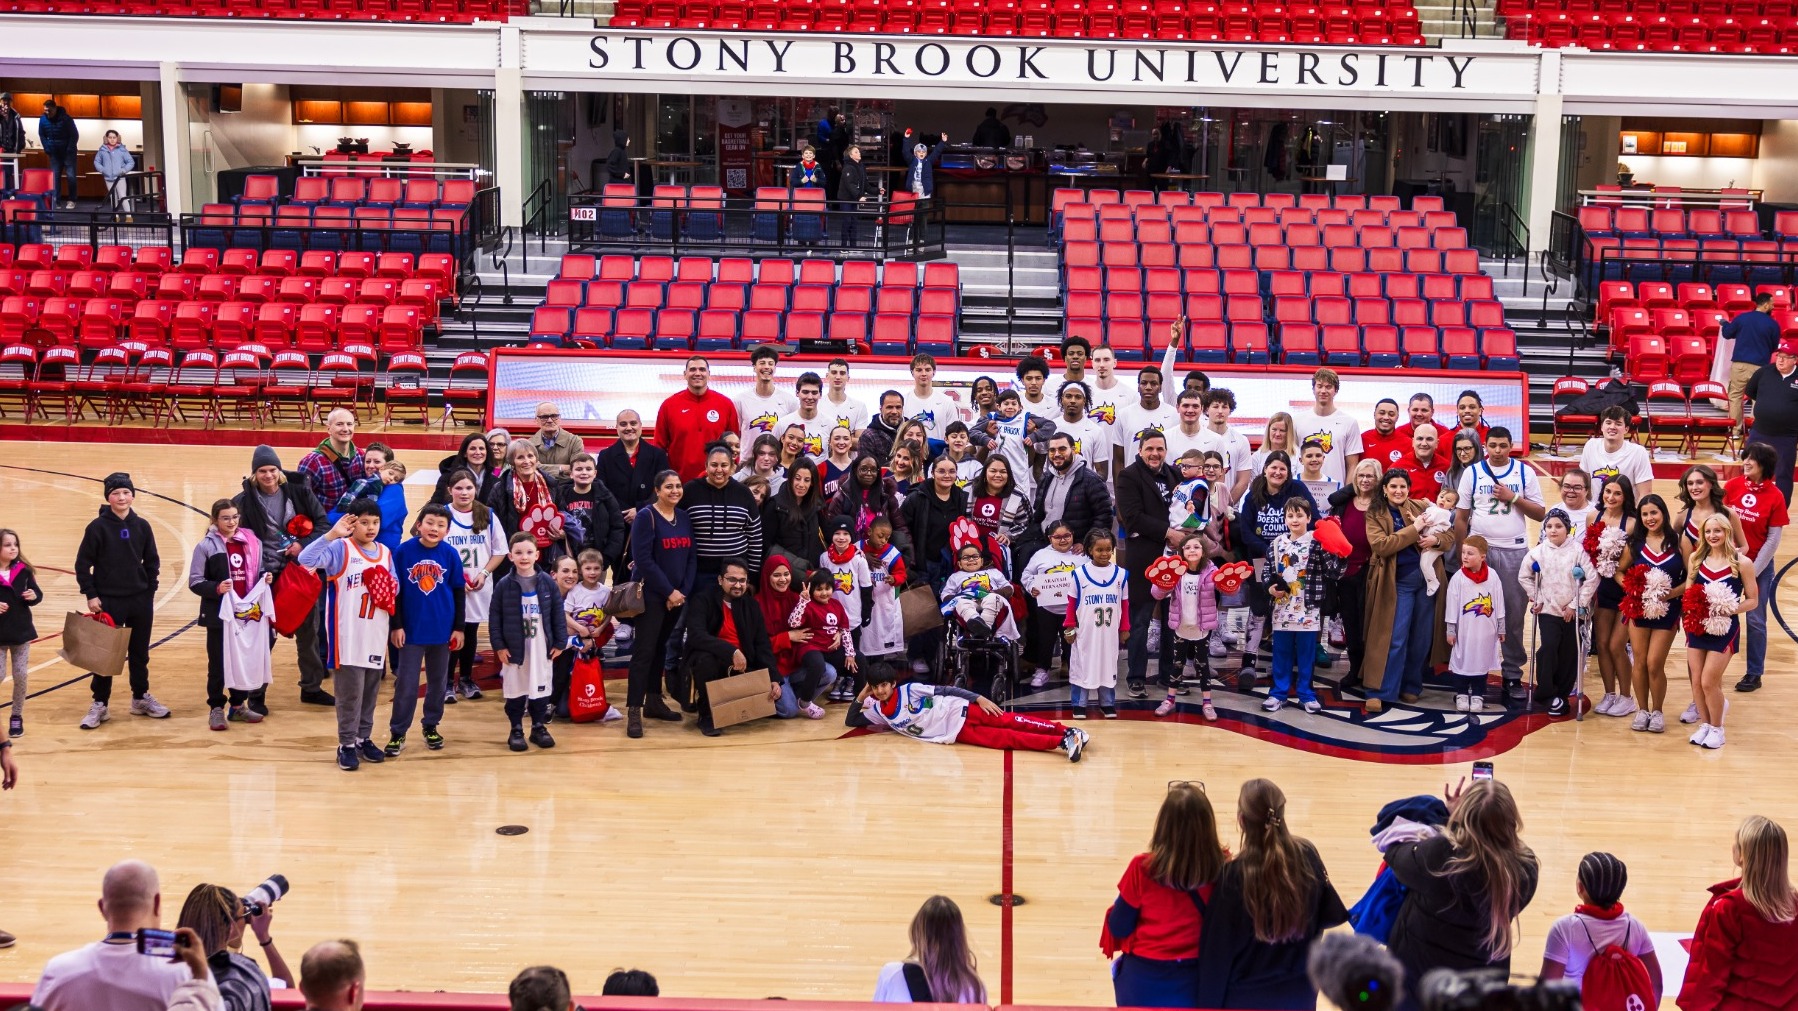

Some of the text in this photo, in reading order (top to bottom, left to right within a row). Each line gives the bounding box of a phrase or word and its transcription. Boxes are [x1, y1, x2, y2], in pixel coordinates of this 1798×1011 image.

[589, 35, 1476, 89] STONY BROOK UNIVERSITY
[1600, 382, 1609, 390] STO
[824, 480, 839, 495] STON
[460, 548, 478, 568] 21
[1085, 594, 1104, 605] STONY
[530, 604, 540, 614] BRO
[1094, 607, 1113, 628] 33
[1014, 716, 1056, 729] Champion
